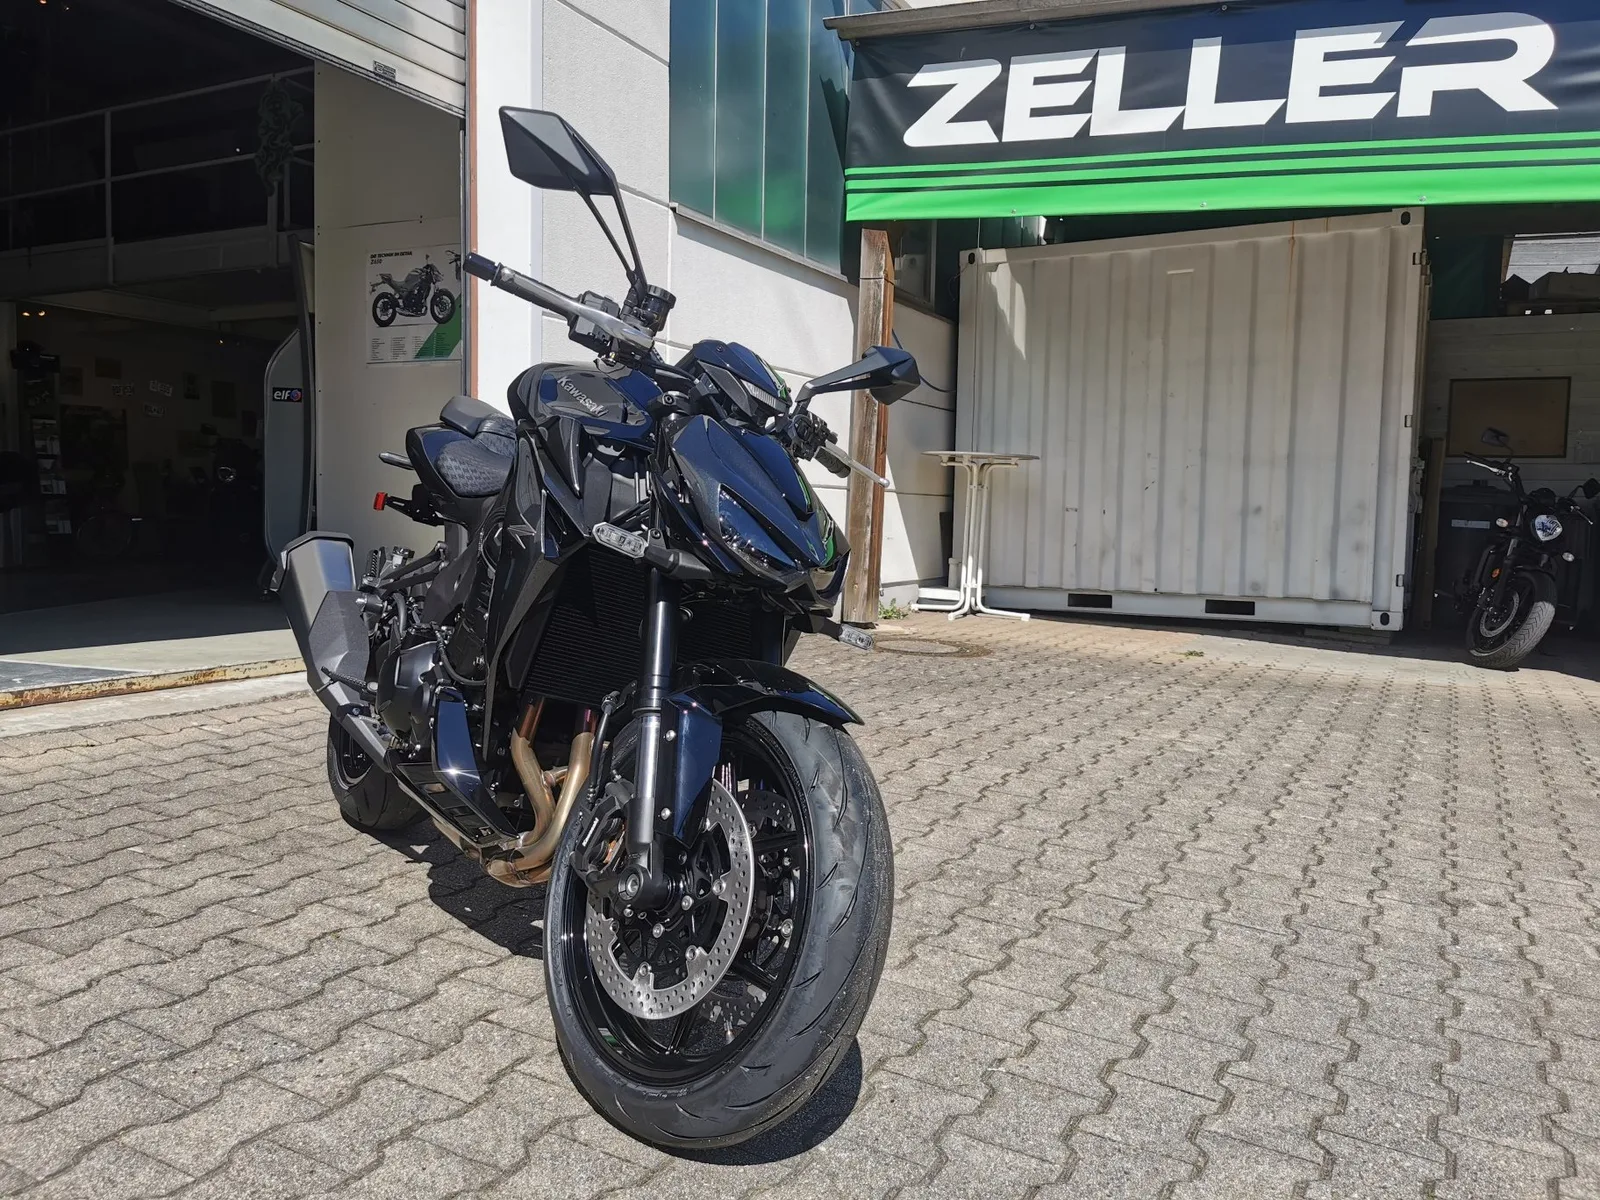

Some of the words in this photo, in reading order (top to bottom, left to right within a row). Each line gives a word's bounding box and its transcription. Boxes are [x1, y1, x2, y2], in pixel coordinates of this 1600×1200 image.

[903, 12, 1557, 148] ZELLER
[273, 390, 291, 400] elf
[557, 376, 609, 416] Kawasaki
